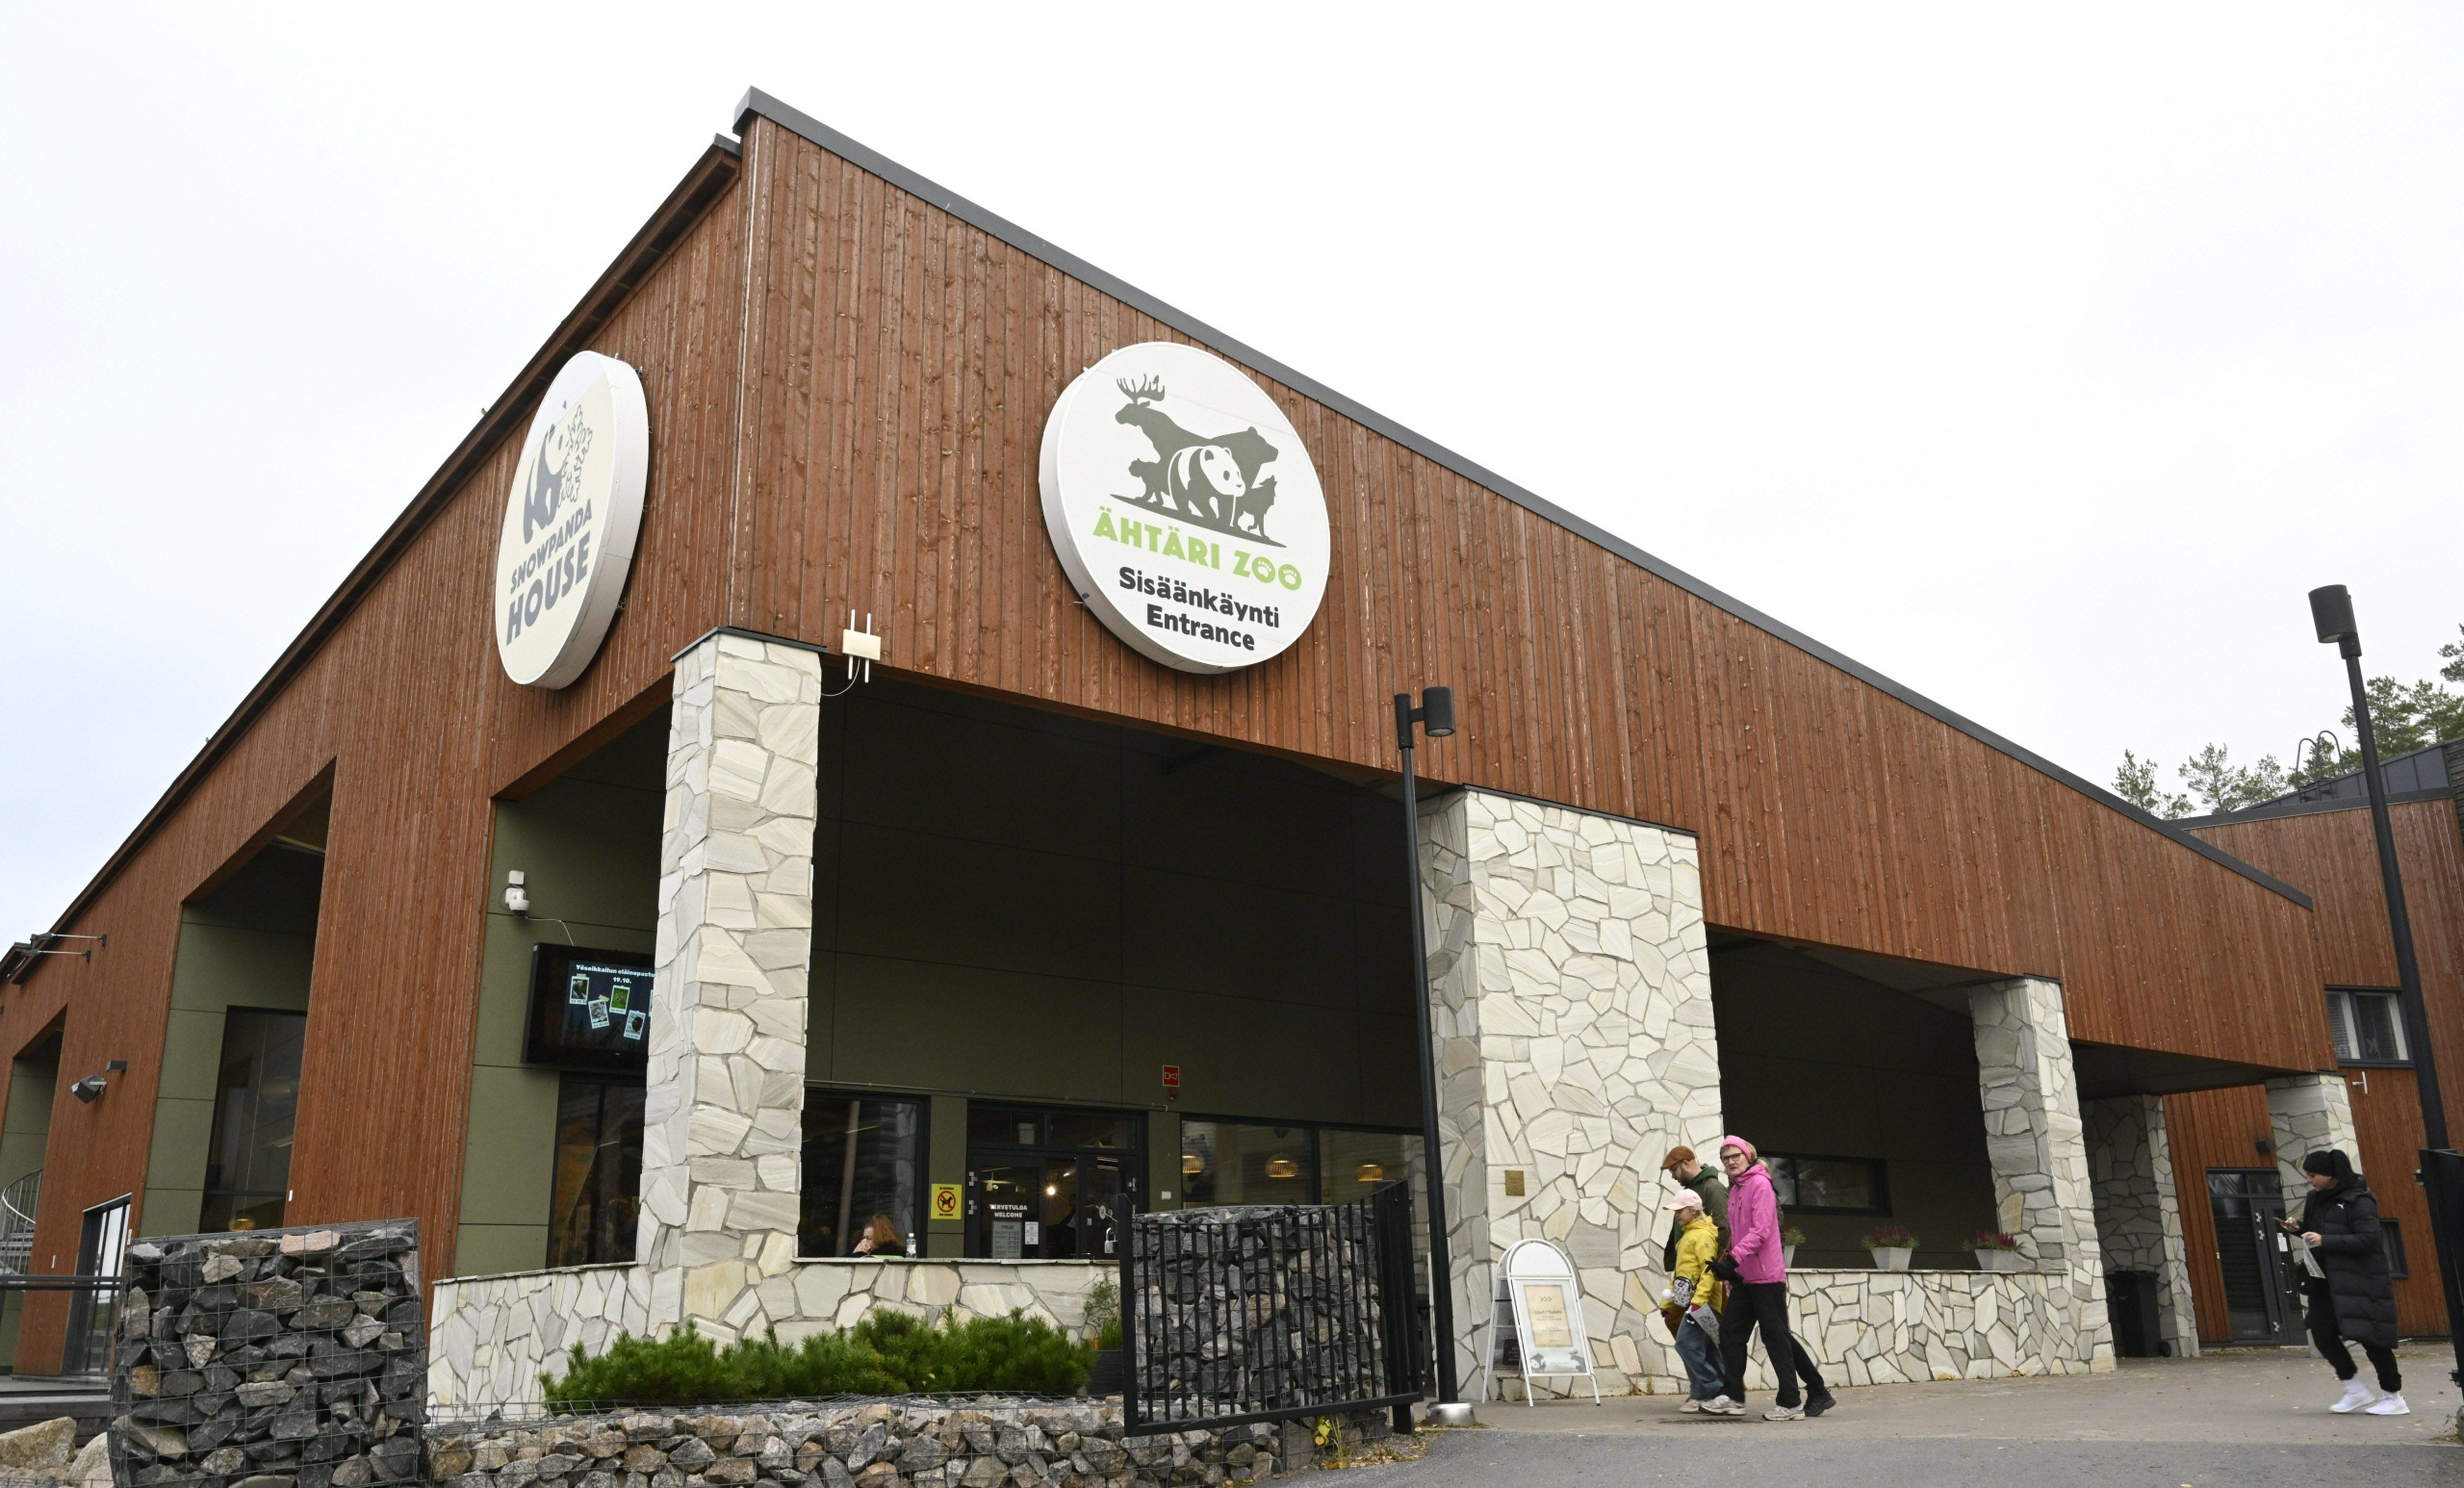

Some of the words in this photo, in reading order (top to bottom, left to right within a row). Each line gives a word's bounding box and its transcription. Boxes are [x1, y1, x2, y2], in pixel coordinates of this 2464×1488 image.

[510, 499, 592, 595] SNOWPANDA
[1092, 505, 1220, 571] ÄHTÄRI
[1232, 549, 1302, 591] ZOO
[505, 530, 591, 647] HOUSE
[1119, 566, 1279, 629] Sisäänkäynti
[1146, 603, 1255, 652] Entrance
[576, 964, 617, 974] Yöseikkailun
[618, 969, 655, 977] eläinopastu
